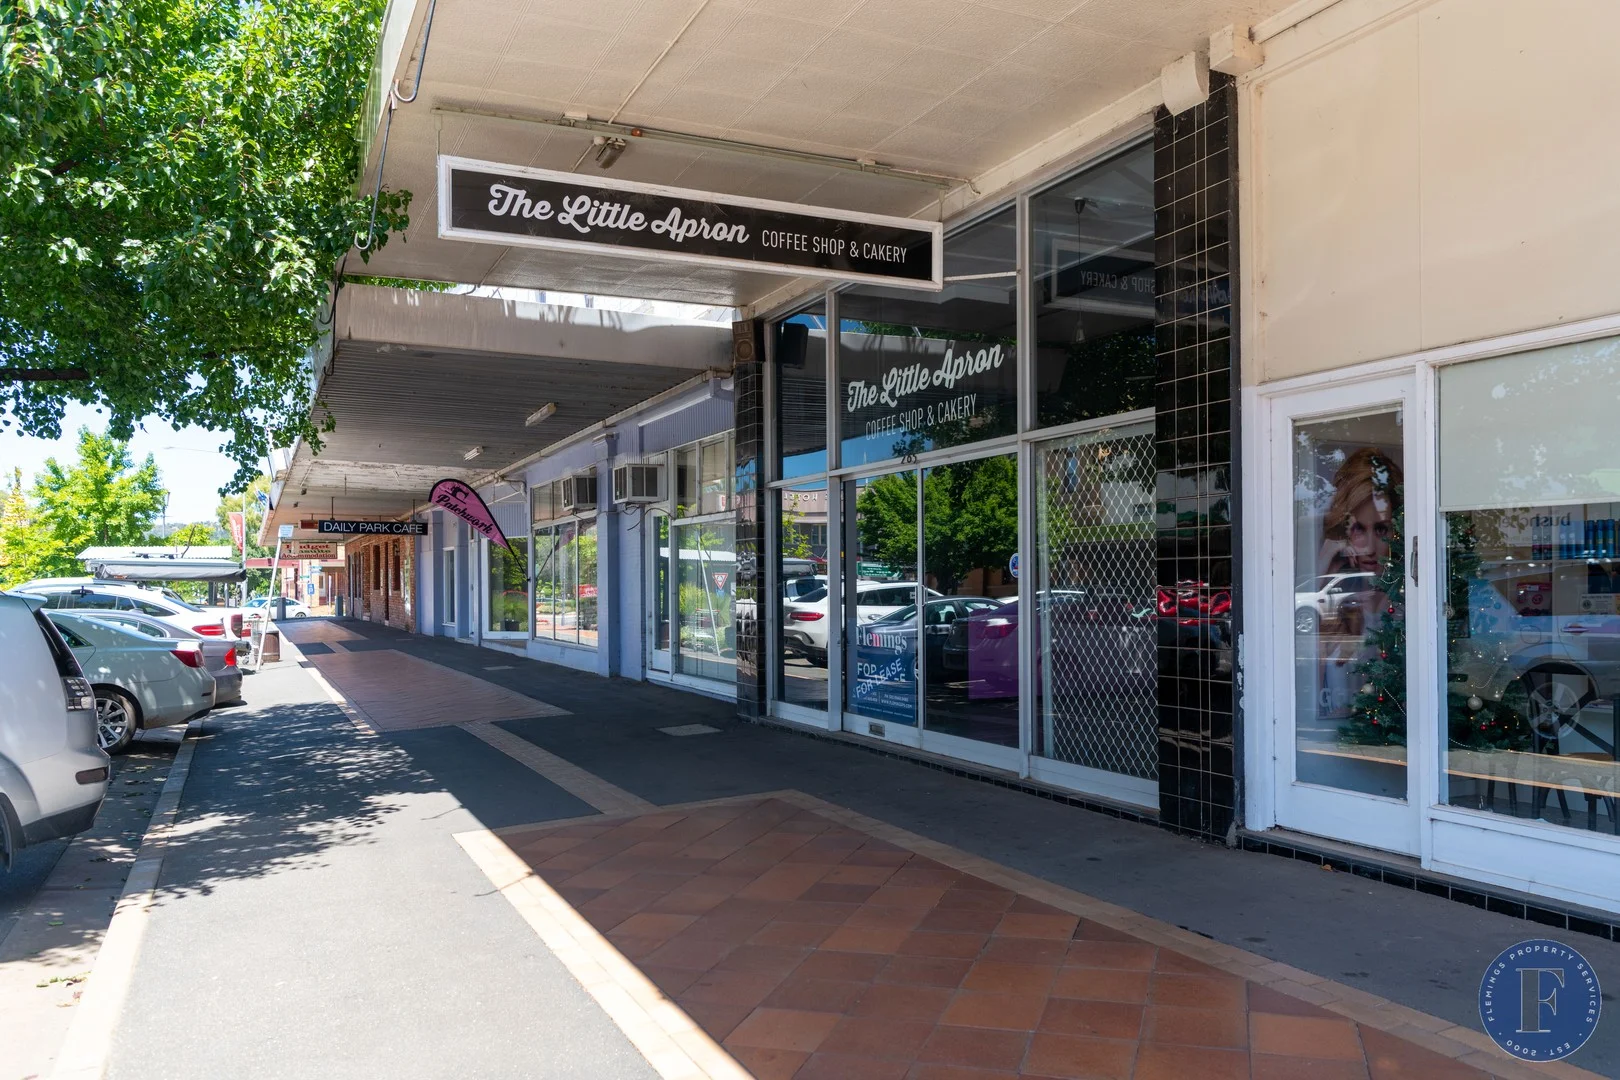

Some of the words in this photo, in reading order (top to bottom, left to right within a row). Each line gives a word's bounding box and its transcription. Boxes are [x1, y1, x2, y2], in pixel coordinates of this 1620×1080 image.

[488, 184, 554, 220] The
[557, 194, 648, 234] Little
[650, 206, 750, 243] Apron
[762, 230, 808, 252] COFFEE
[812, 237, 845, 256] SHOP
[850, 241, 859, 258] &
[863, 243, 907, 263] CAKERY
[847, 380, 878, 412] The
[880, 363, 931, 408] Little
[932, 344, 1004, 389] Apron
[865, 414, 896, 441] COFFEE
[899, 407, 924, 432] SHOP
[926, 405, 935, 426] &
[938, 393, 977, 424] CAKERY
[324, 521, 356, 532] DAILY
[359, 522, 391, 533] PARK
[393, 524, 423, 534] CAFE
[436, 494, 493, 535] Patchwork
[856, 626, 907, 655] Flemings
[856, 679, 874, 698] FOR
[874, 658, 903, 684] LEASE
